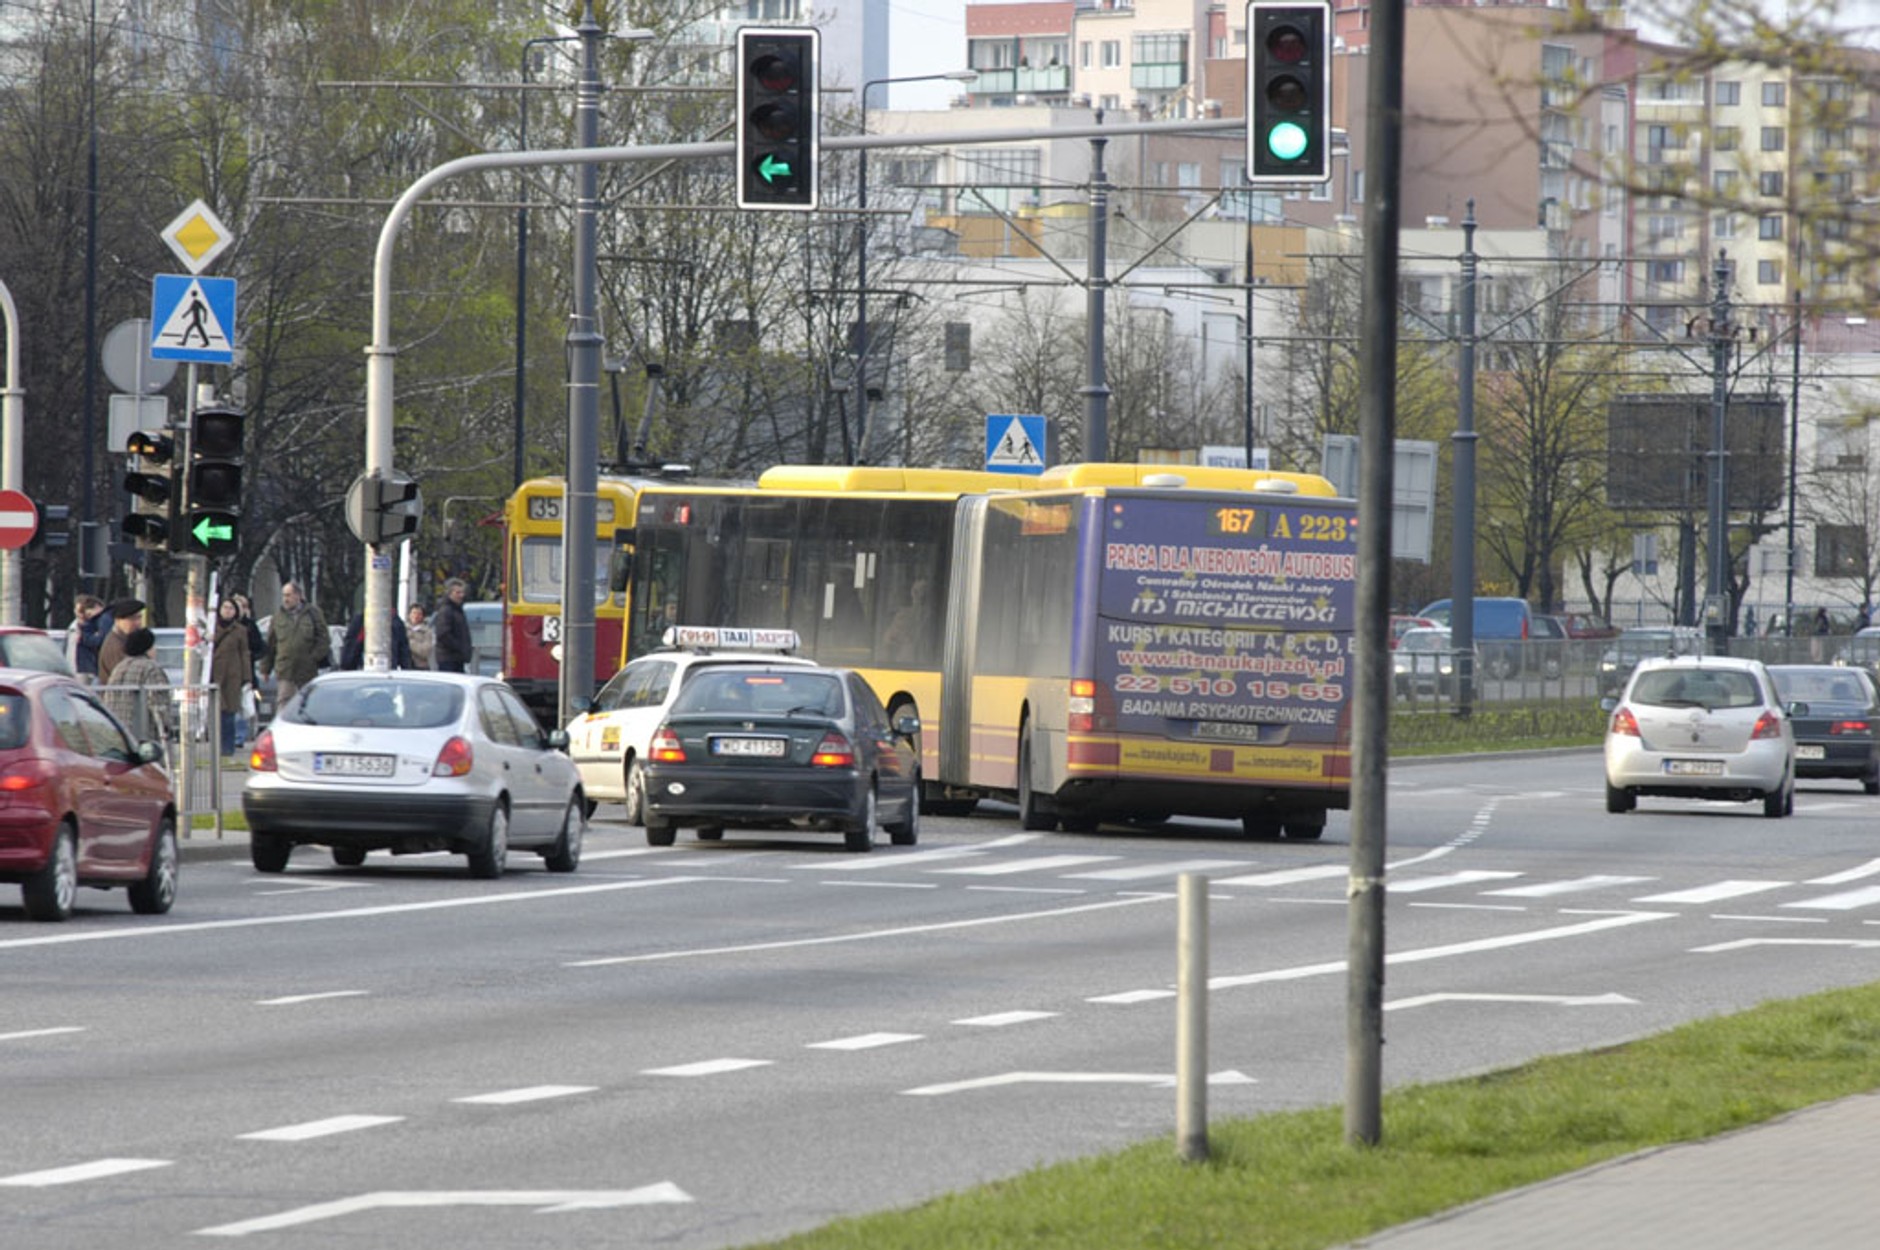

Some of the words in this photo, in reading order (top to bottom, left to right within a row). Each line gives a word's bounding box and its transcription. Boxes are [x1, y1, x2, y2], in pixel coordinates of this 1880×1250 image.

[534, 497, 560, 518] 35
[1215, 508, 1255, 533] 167
[1273, 513, 1292, 539] A
[1300, 515, 1347, 542] 223
[1106, 543, 1157, 570] PRACA
[1160, 546, 1188, 572] DLA
[1192, 544, 1282, 576] KIEROWCÓW
[724, 631, 749, 642] TAXI
[1108, 625, 1164, 645] KURSY
[1168, 627, 1255, 649] KATEGORII
[1117, 650, 1345, 677] www.itsnaukajazdy.pl
[1116, 674, 1160, 692] 22
[1170, 677, 1237, 695] 510
[1247, 681, 1289, 698] 15
[1299, 684, 1343, 701] 55
[1122, 699, 1185, 717] BADANIA
[1188, 702, 1338, 724] PSYCHOTECHNICZNE
